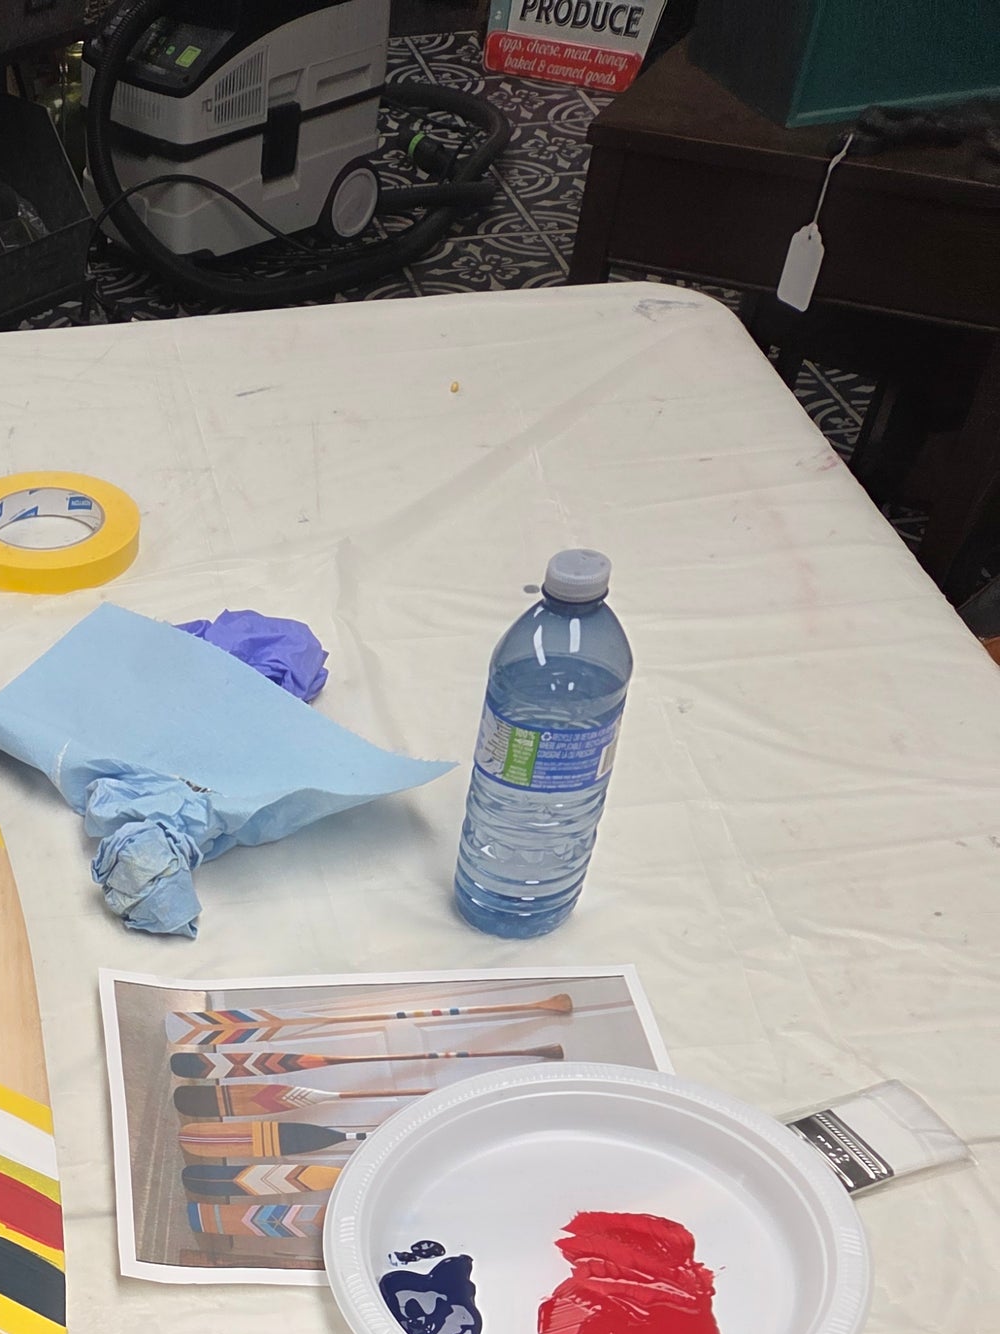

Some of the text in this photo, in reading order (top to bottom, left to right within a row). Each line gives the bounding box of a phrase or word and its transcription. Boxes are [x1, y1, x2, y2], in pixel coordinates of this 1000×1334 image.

[520, 0, 644, 39] PRODUCE
[499, 36, 524, 51] eggs,
[526, 39, 562, 58] cheese,
[594, 52, 629, 71] honey,
[504, 53, 616, 87] baked & canned goods
